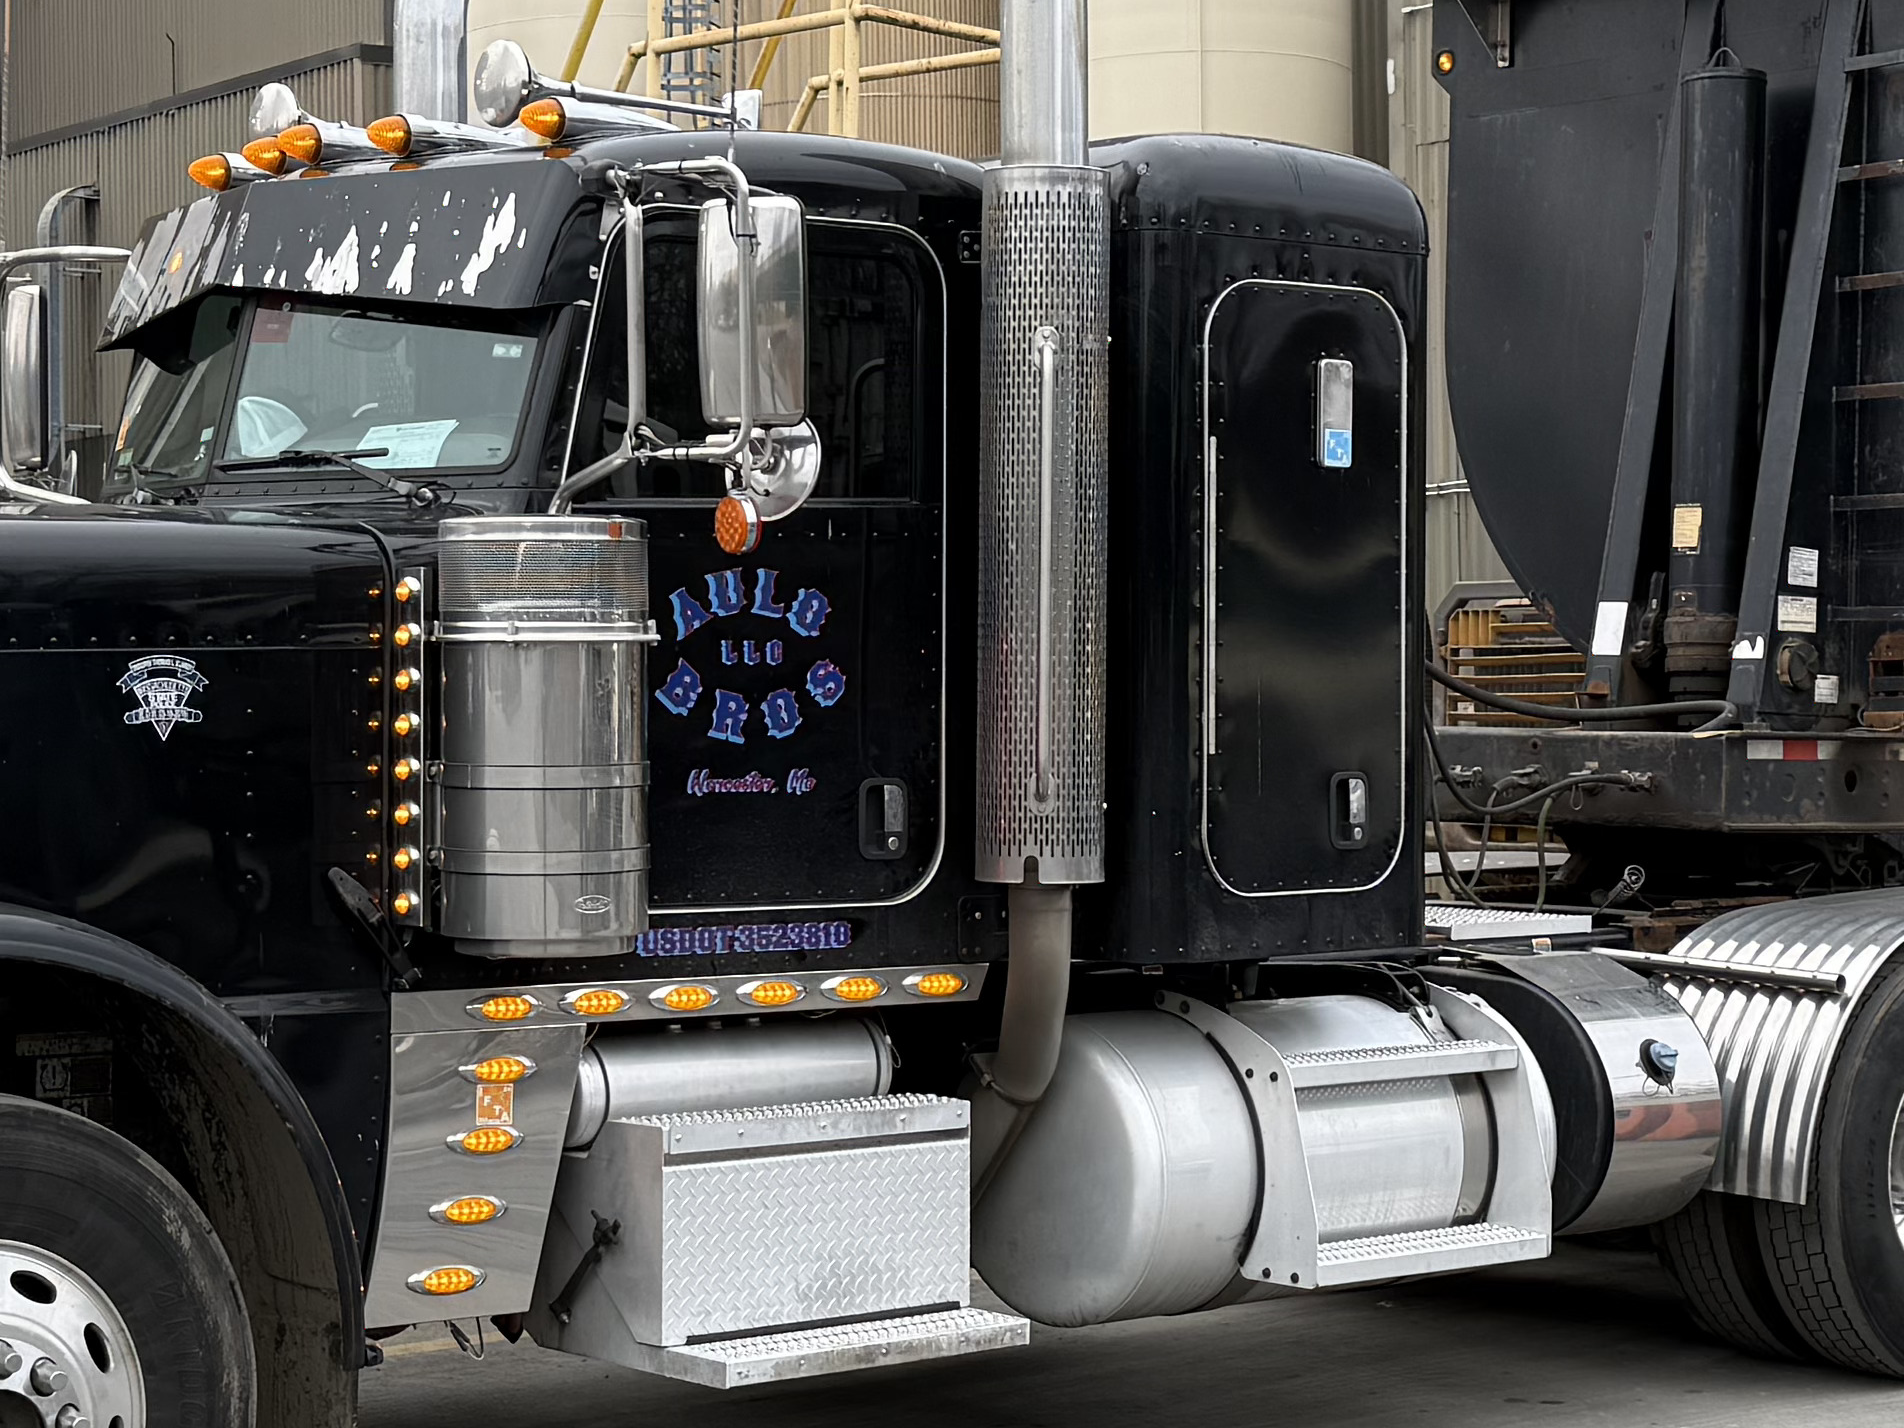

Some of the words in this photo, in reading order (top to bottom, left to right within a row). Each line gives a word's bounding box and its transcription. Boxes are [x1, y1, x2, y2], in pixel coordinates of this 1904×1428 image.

[668, 567, 832, 641] AULO
[721, 639, 783, 666] LLC
[655, 657, 846, 744] BROS
